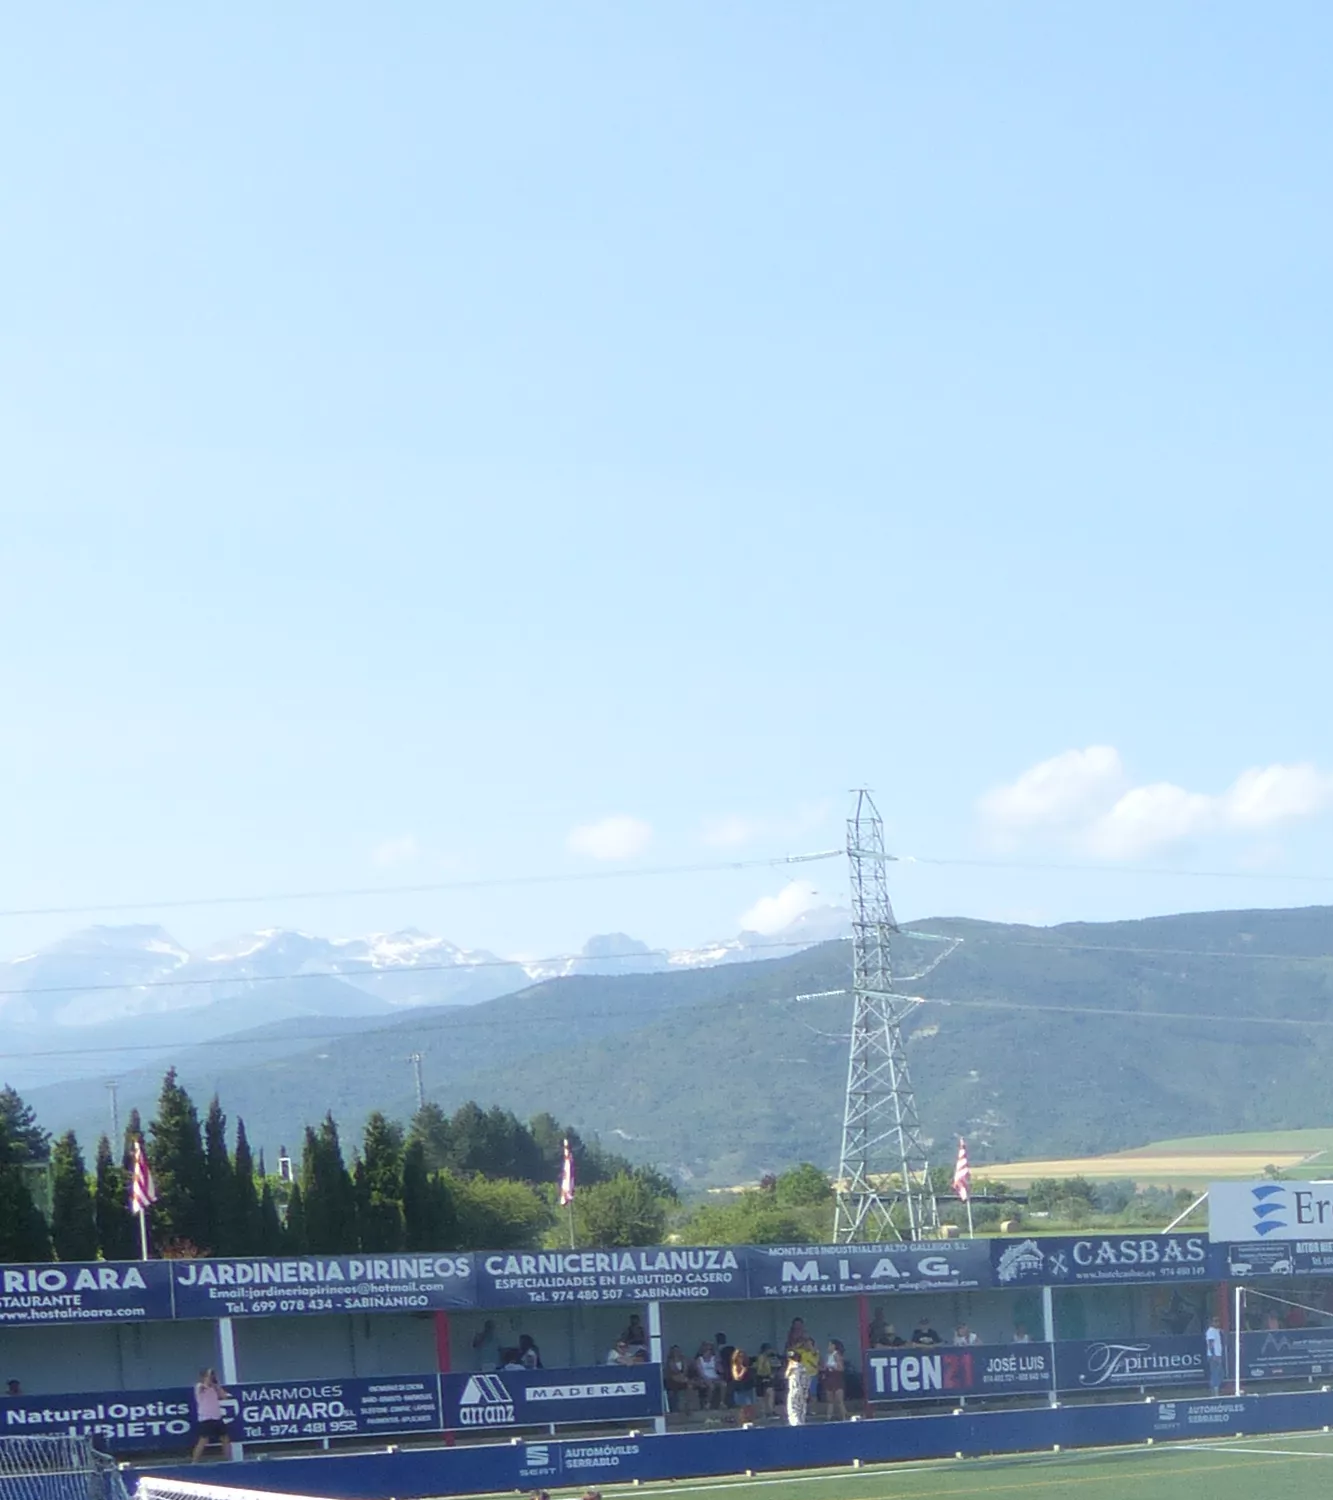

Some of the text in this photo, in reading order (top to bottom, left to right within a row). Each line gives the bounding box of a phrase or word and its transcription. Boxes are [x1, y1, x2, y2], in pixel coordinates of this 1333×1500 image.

[769, 1246, 820, 1258] MONTAJES
[820, 1245, 883, 1256] INDUSTRIALES
[884, 1243, 908, 1253] ALTO
[1072, 1239, 1205, 1267] CASBAS
[177, 1256, 472, 1286] JARDINERIA PIRINEOS
[484, 1250, 738, 1276] CARNICERIA LANUZA
[782, 1260, 830, 1282] M.
[870, 1258, 911, 1279] A.
[917, 1256, 961, 1276] G.
[4, 1266, 147, 1293] RIO ARA
[495, 1272, 733, 1290] ESPECIALIDADES EN EMBUTIDO CASERO
[209, 1282, 444, 1301] Email:jardineriapirineos@hotmail.com
[529, 1291, 550, 1303] Tel.
[551, 1290, 575, 1302] 974
[0, 1294, 82, 1310] TAURANTE
[225, 1301, 249, 1314] Tel.
[251, 1300, 277, 1313] 699
[280, 1299, 305, 1312] 078
[308, 1298, 333, 1311] 434
[986, 1354, 1045, 1372] JOSÉ LUIS
[242, 1385, 343, 1402] MÁRMOLES
[531, 1383, 642, 1399] MADERAS
[6, 1400, 190, 1426] Natural Optics
[242, 1401, 344, 1423] GAMARO
[243, 1425, 266, 1439] Tel.
[270, 1423, 300, 1437] 974
[328, 1420, 358, 1434] 952
[564, 1443, 640, 1460] AUTOMÓVILES
